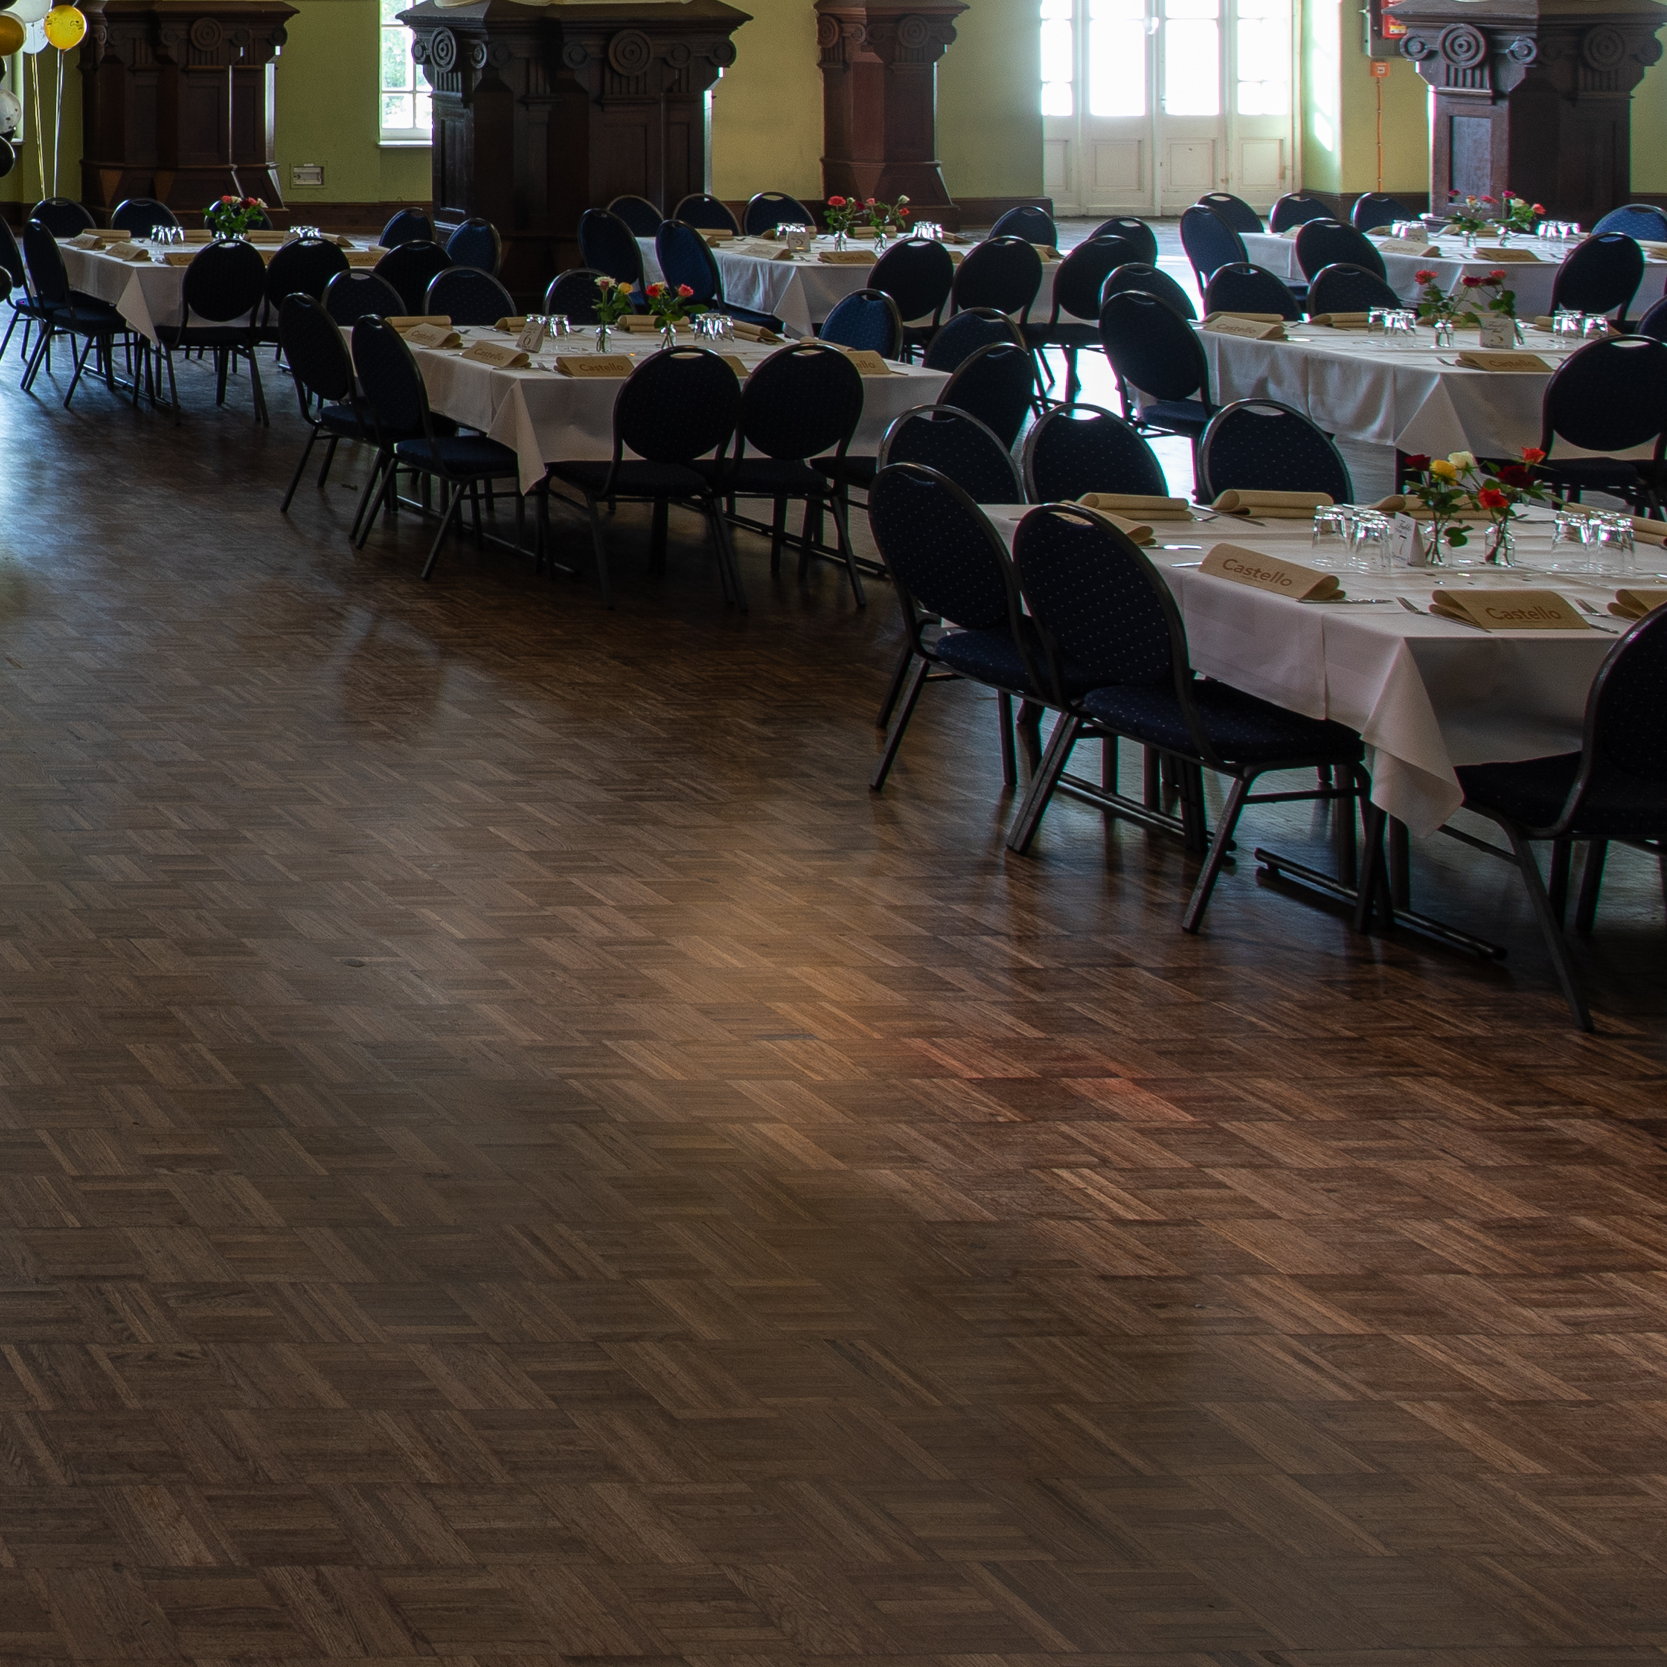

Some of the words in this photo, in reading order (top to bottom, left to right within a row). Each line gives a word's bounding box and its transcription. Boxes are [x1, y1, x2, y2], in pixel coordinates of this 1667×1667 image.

[1216, 323, 1257, 334] Castello
[474, 348, 504, 361] Castello
[579, 363, 624, 373] Castello
[856, 360, 876, 370] ello
[1488, 359, 1536, 368] Castello
[1399, 534, 1408, 556] 7
[1222, 558, 1293, 587] Castello
[1485, 606, 1562, 620] Castello
